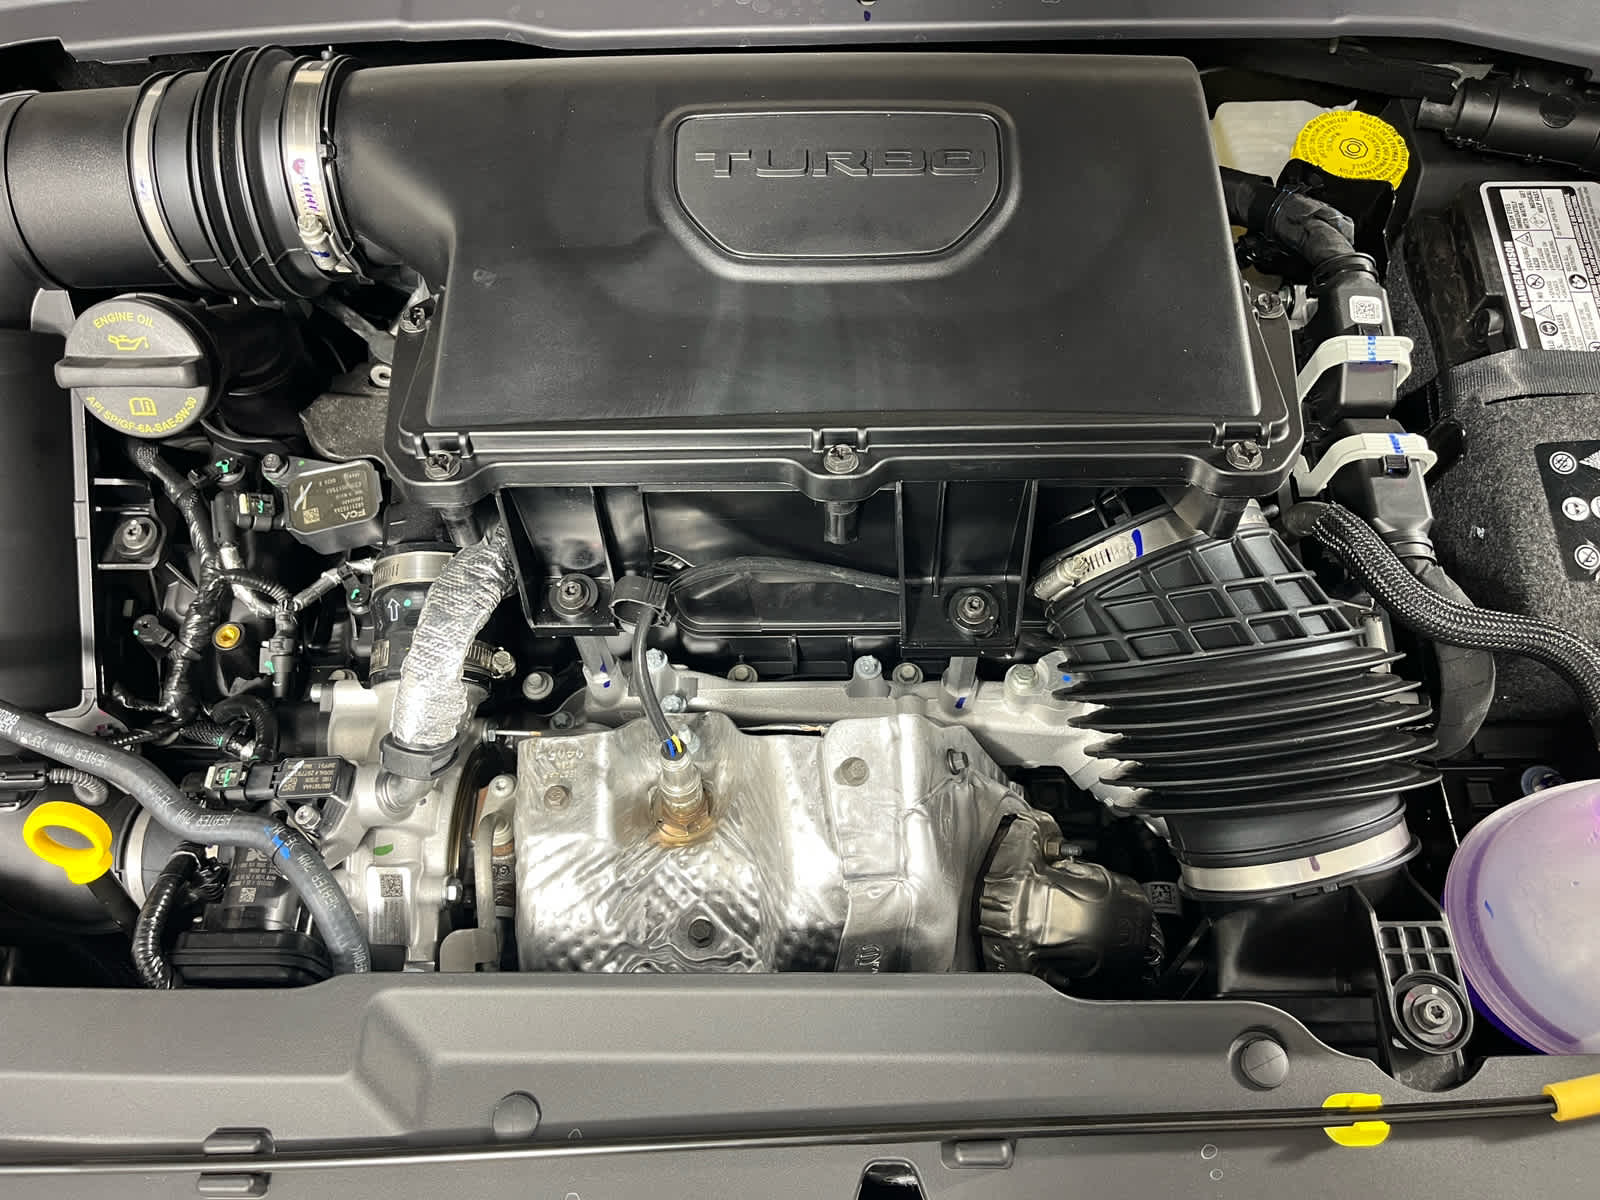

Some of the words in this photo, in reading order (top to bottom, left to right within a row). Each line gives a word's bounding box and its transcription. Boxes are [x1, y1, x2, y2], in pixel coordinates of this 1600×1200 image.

[695, 149, 985, 178] TURBO
[1503, 241, 1531, 308] DANGER/POISON
[93, 312, 134, 328] ENGINE
[137, 314, 154, 327] OIL
[87, 396, 104, 413] API
[341, 508, 366, 520] FCA
